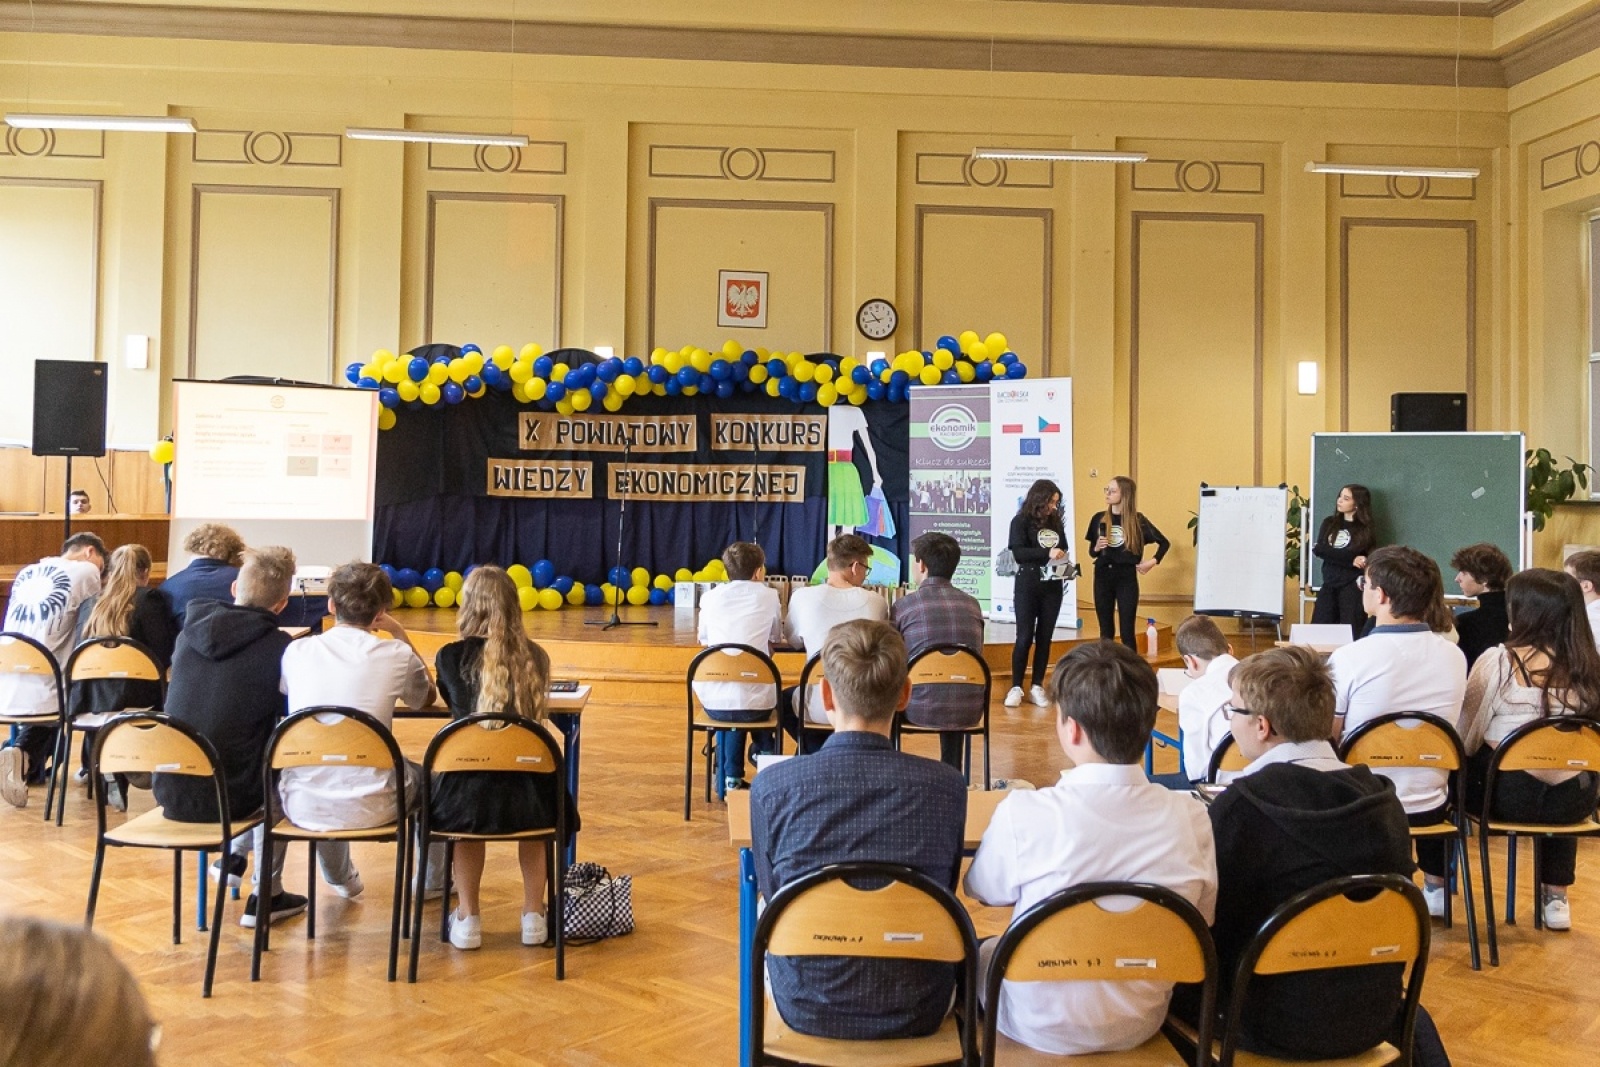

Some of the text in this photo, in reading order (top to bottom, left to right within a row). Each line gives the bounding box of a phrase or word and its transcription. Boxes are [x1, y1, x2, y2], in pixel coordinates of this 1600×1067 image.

[525, 418, 541, 442] X
[715, 418, 823, 446] KONKURS
[930, 423, 976, 432] ekonomik
[915, 458, 941, 466] Klucz
[943, 457, 954, 466] do
[493, 465, 800, 496] WIEDZY EKONOMICZNEJ
